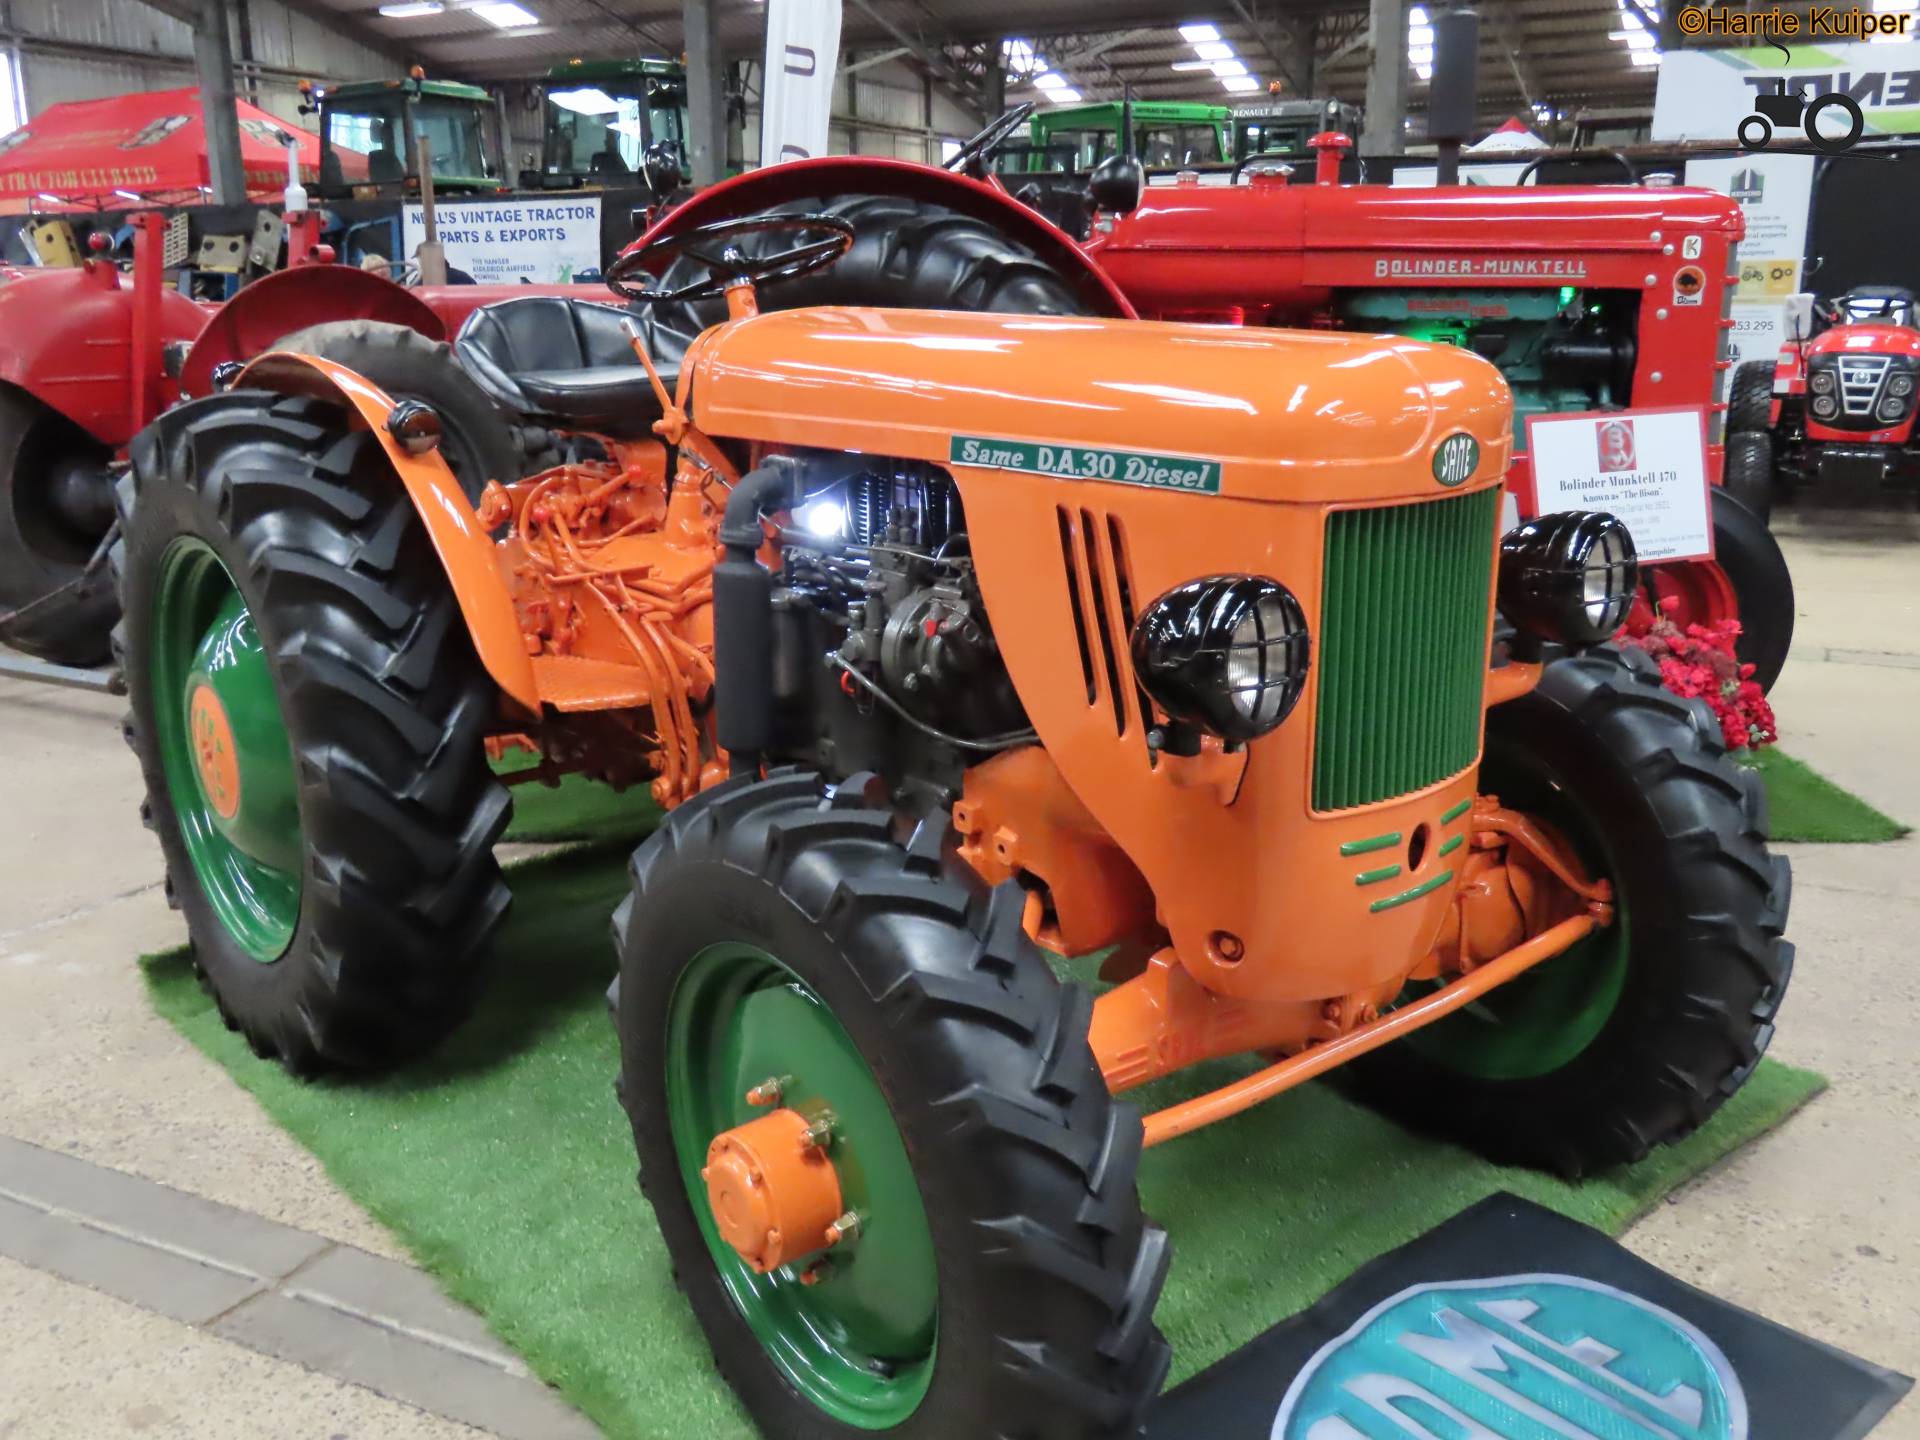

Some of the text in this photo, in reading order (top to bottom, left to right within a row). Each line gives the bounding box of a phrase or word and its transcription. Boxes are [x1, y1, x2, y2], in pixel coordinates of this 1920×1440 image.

[1233, 109, 1270, 117] RENAULT
[7, 170, 78, 191] TRACTOR
[461, 209, 522, 224] VINTAGE
[527, 206, 595, 221] TRACTOR
[440, 227, 566, 243] PARTS & EXPORTS
[1375, 259, 1587, 278] BOLINDER-MUNKTELL
[1753, 321, 1774, 330] 295
[962, 440, 1211, 489] Same D.A.30 Diesel
[1442, 437, 1472, 481] SAME
[1559, 479, 1606, 491] Bolinder
[1609, 473, 1656, 486] Munktell
[1583, 493, 1609, 502] Known
